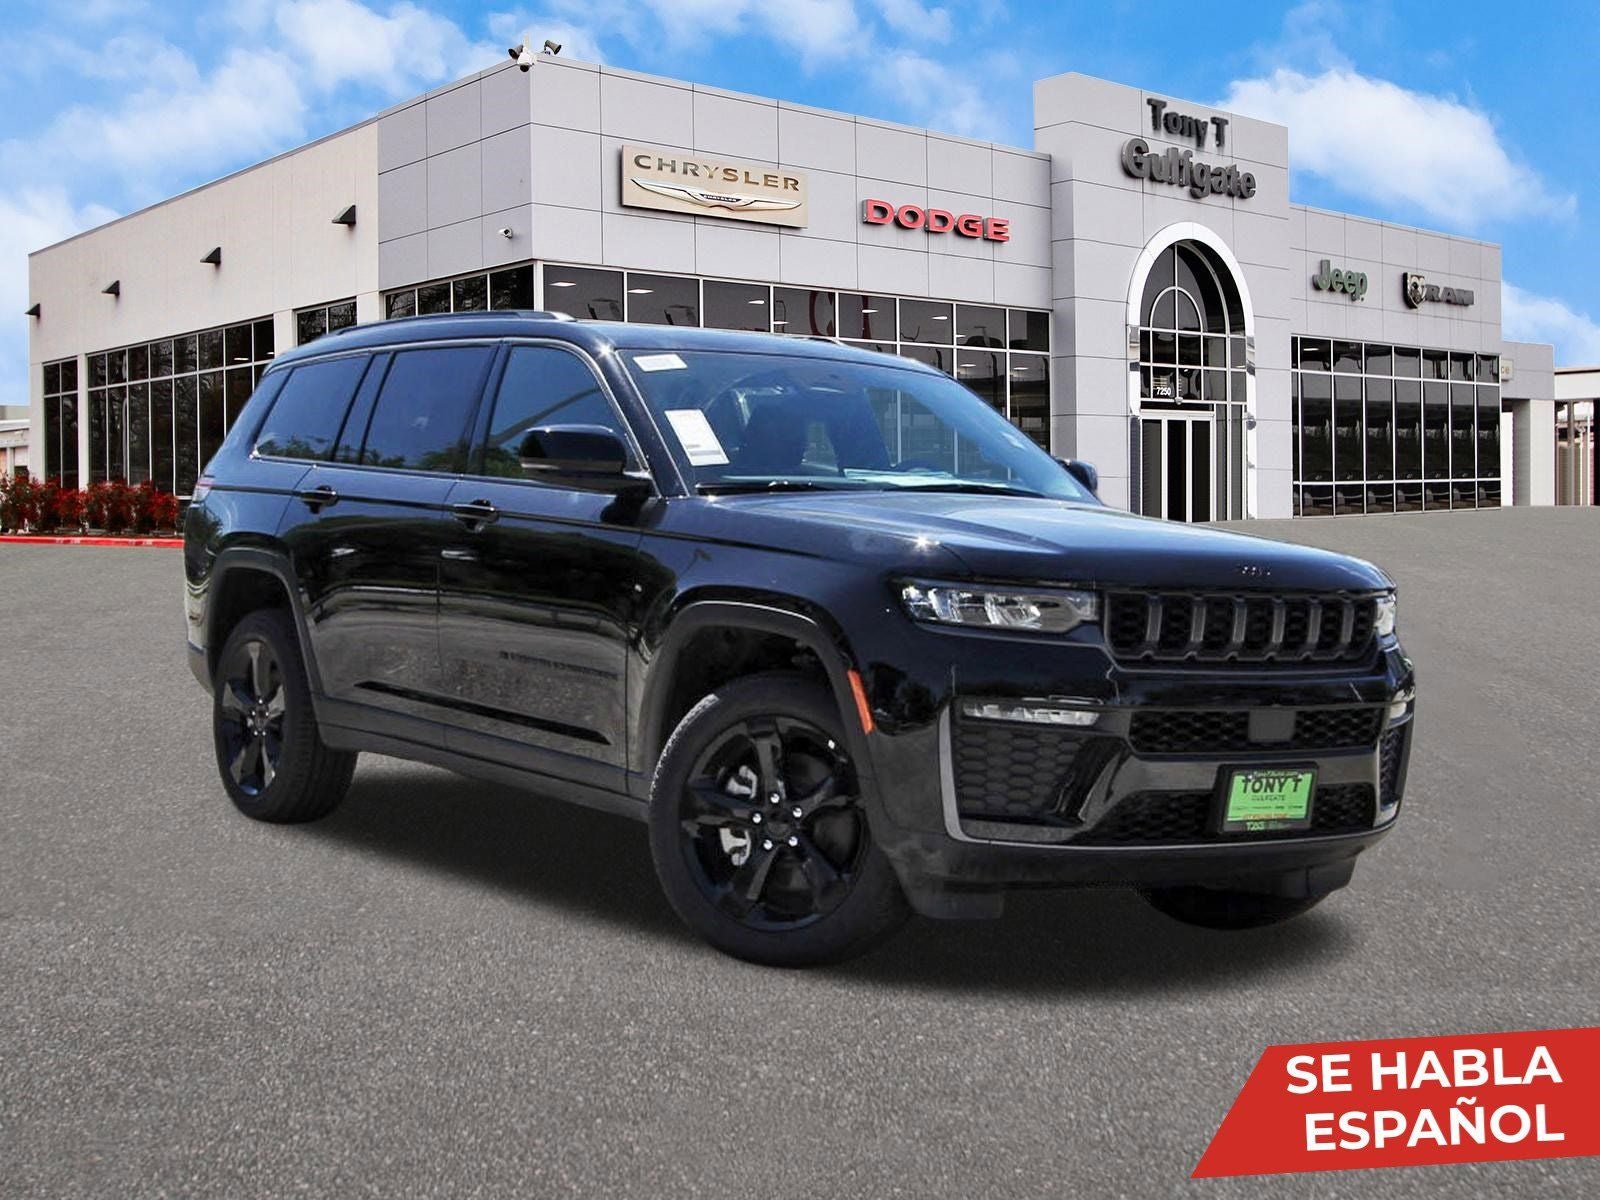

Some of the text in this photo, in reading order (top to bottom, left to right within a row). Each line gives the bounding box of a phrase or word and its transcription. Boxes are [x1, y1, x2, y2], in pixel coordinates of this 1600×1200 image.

[1146, 98, 1229, 147] Tony T
[633, 154, 800, 191] CHRYSLER
[1121, 138, 1256, 199] Gulfgate
[863, 197, 1010, 242] DODGE
[1312, 259, 1368, 302] Jeep
[1425, 284, 1474, 306] RAM
[1156, 387, 1171, 396] 7250
[1242, 776, 1302, 793] TONY T
